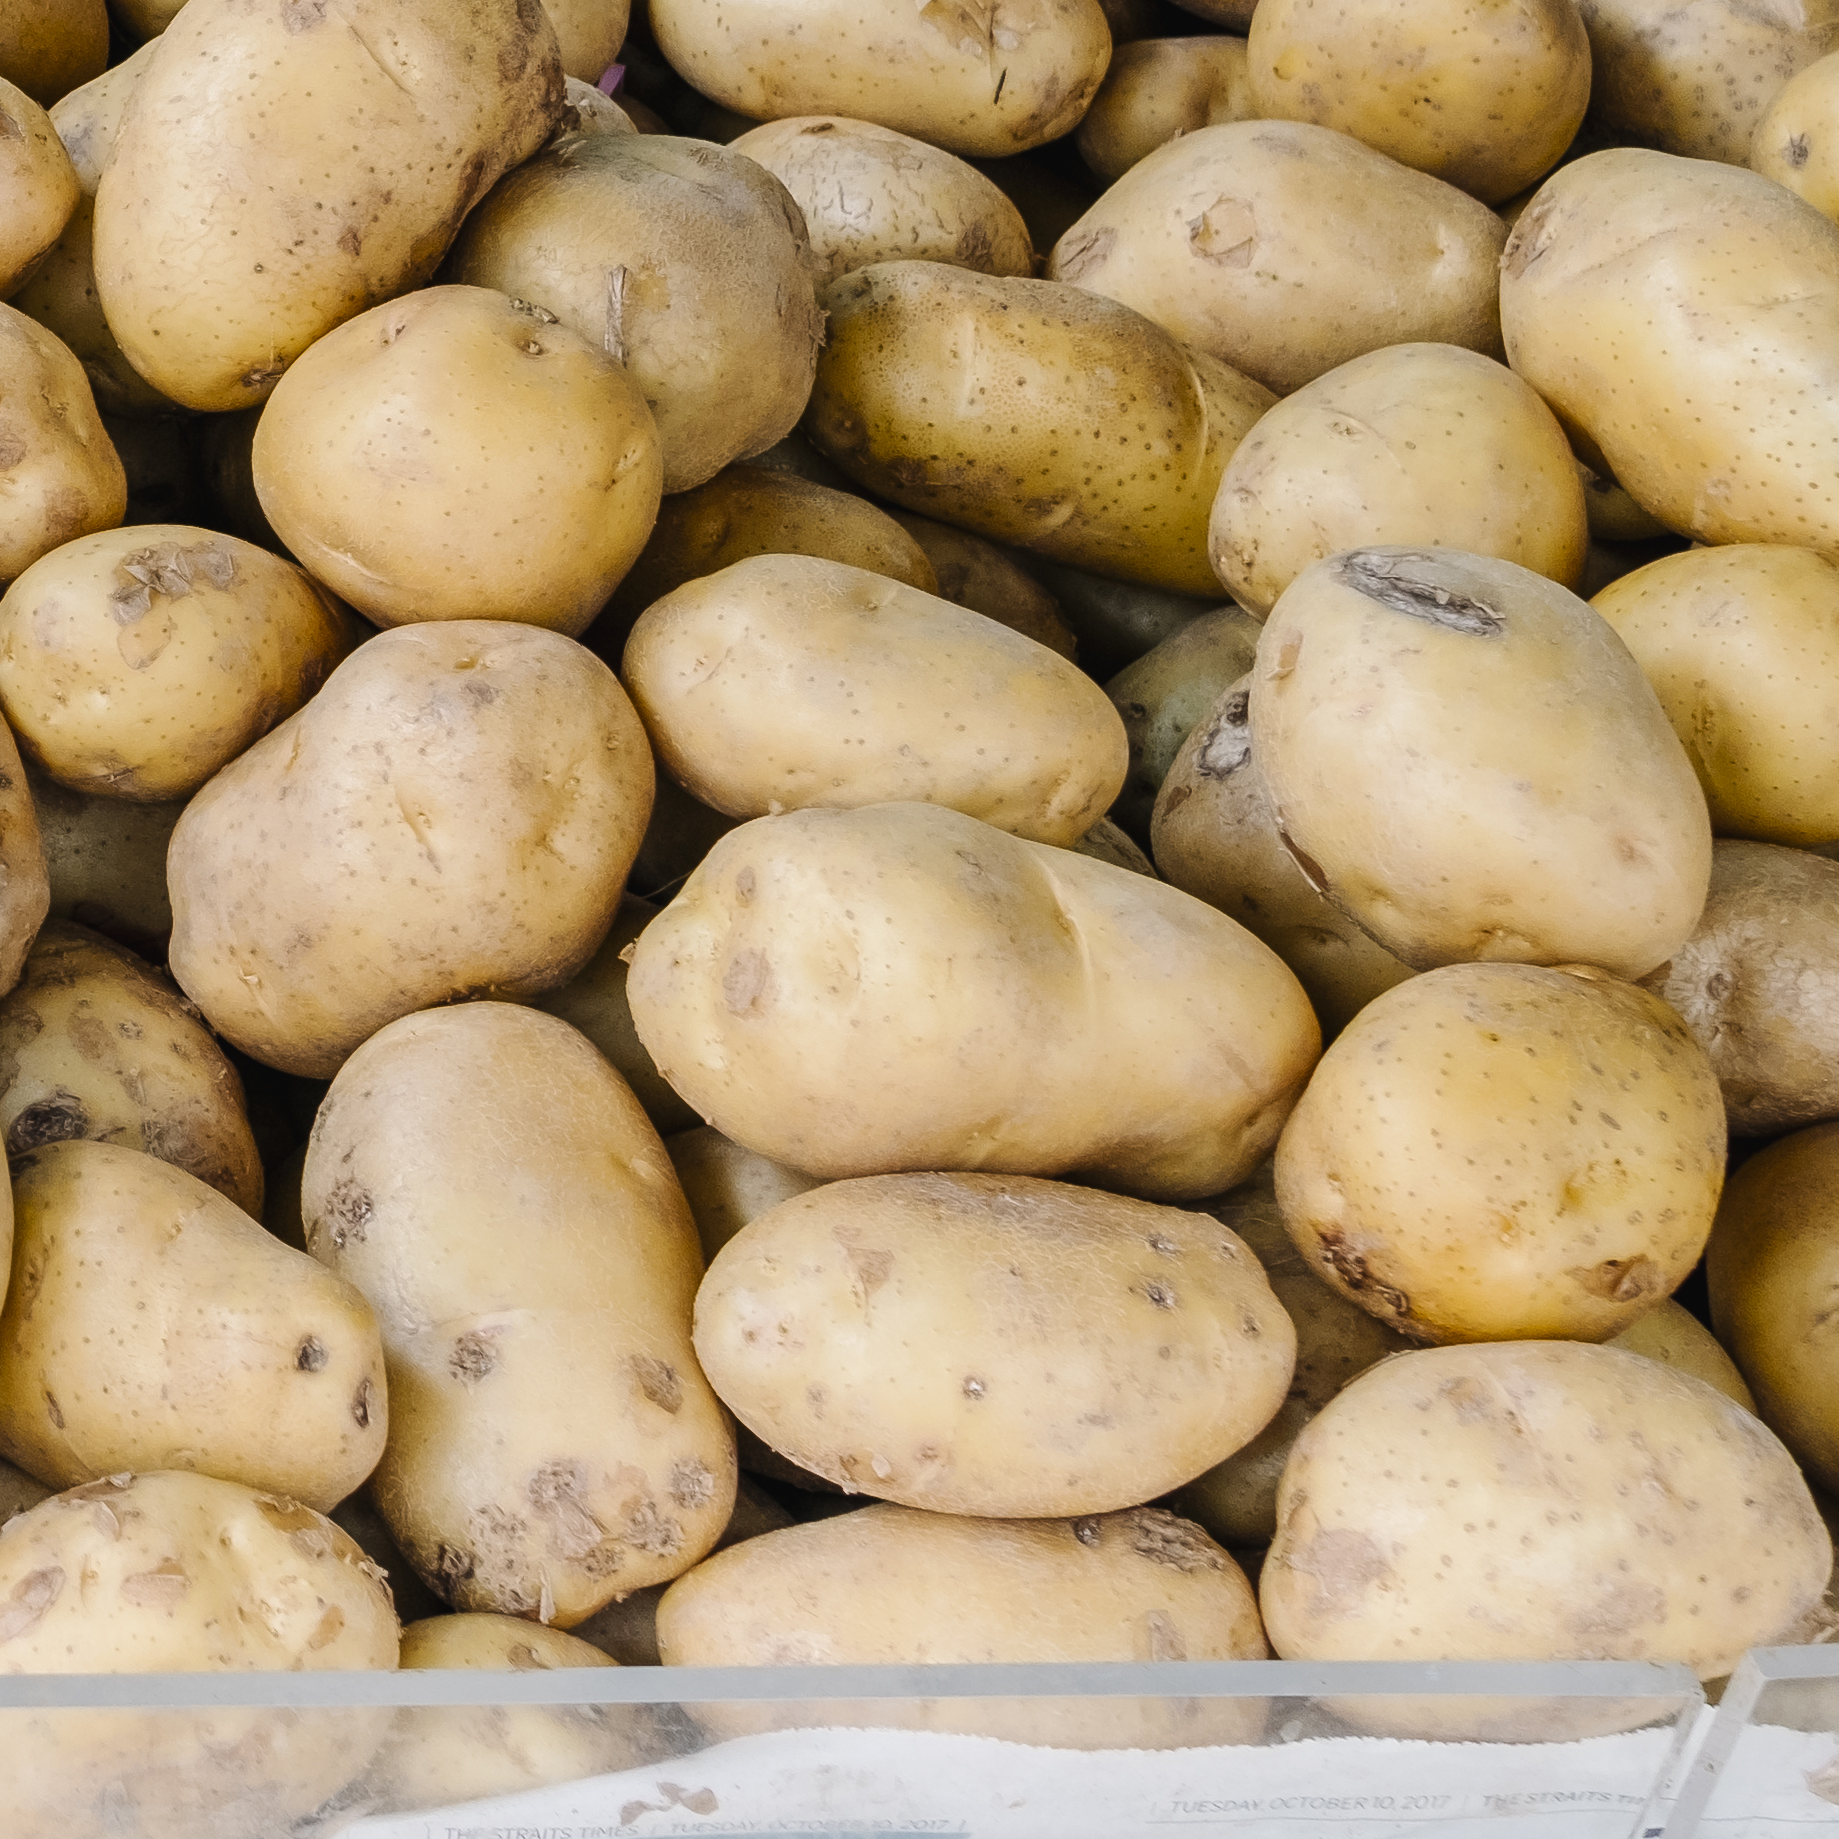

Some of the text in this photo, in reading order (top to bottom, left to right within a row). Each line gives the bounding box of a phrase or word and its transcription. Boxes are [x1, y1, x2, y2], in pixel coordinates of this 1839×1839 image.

[1269, 1796, 1369, 1810] OCTOBER
[1400, 1795, 1452, 1810] 2017
[1524, 1790, 1612, 1805] STRAITS
